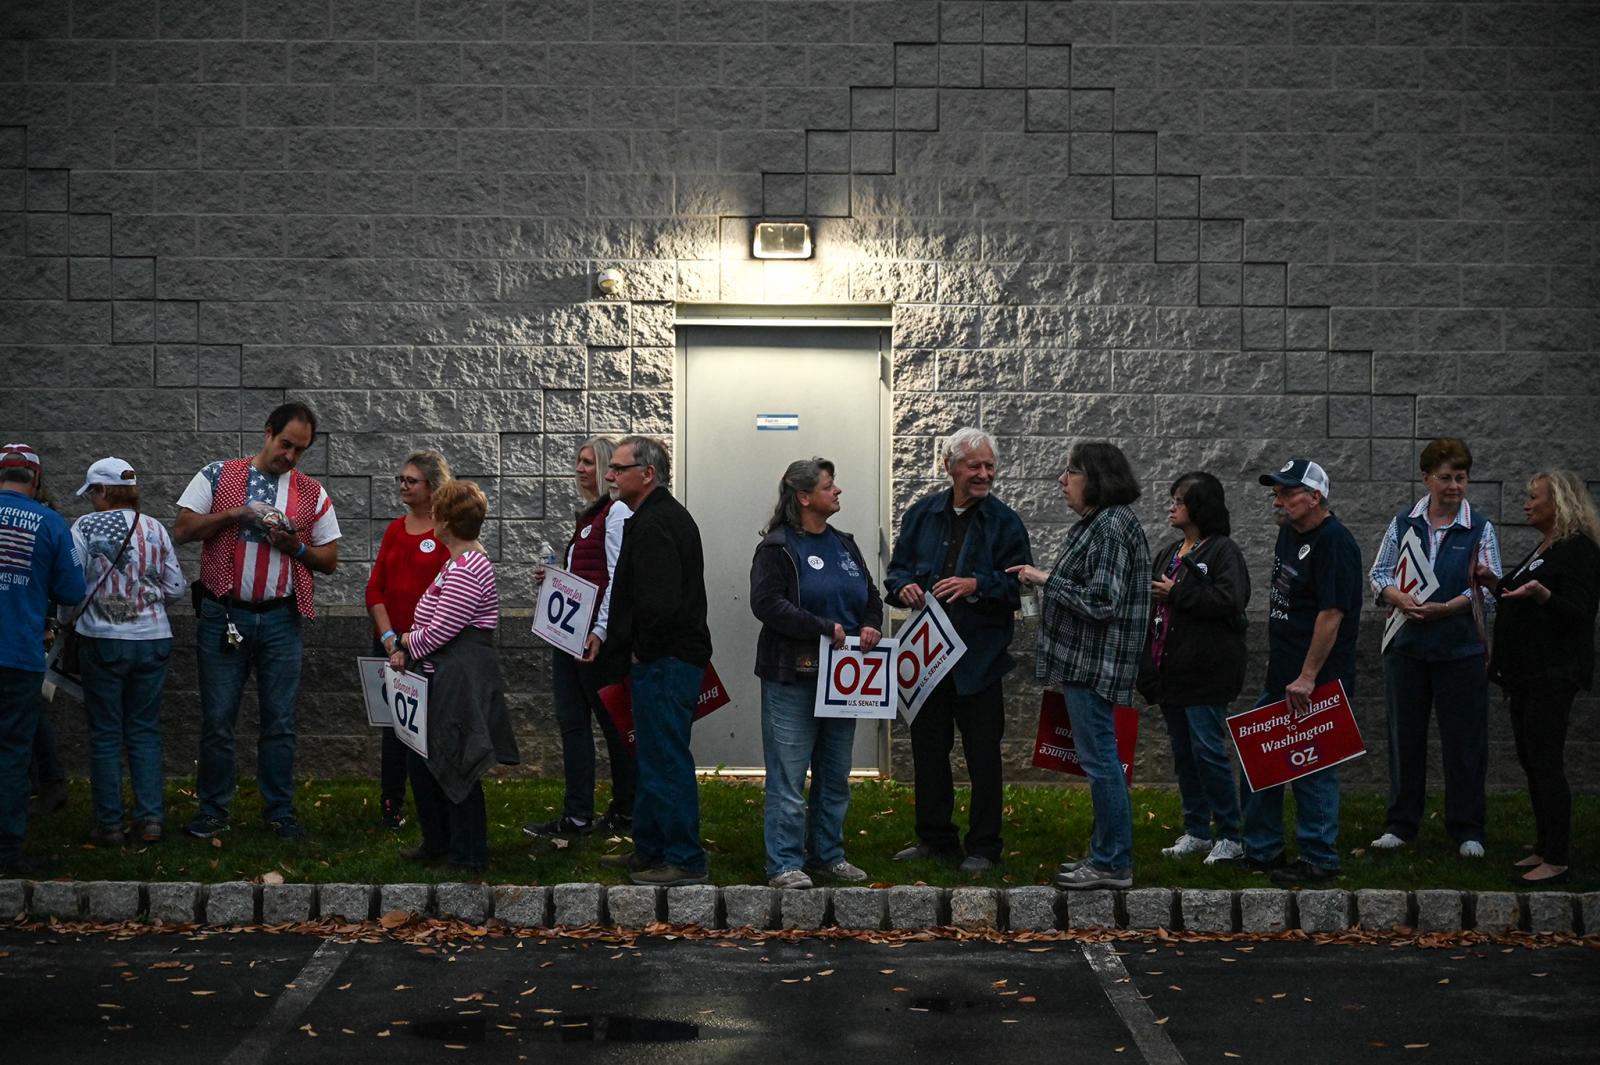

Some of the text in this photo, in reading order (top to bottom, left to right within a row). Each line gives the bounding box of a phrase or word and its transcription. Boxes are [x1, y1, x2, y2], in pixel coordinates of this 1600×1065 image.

[12, 517, 40, 532] LAW
[13, 574, 30, 586] DUTY
[552, 577, 572, 597] Women
[547, 591, 580, 635] OZ
[897, 621, 943, 689] OZ
[928, 653, 947, 677] SENATE
[393, 678, 411, 695] Women
[834, 656, 882, 695] OZ
[394, 692, 419, 734] OZ
[1239, 713, 1291, 738] Bringing
[1261, 721, 1334, 754] Washington
[1291, 746, 1318, 766] OZ
